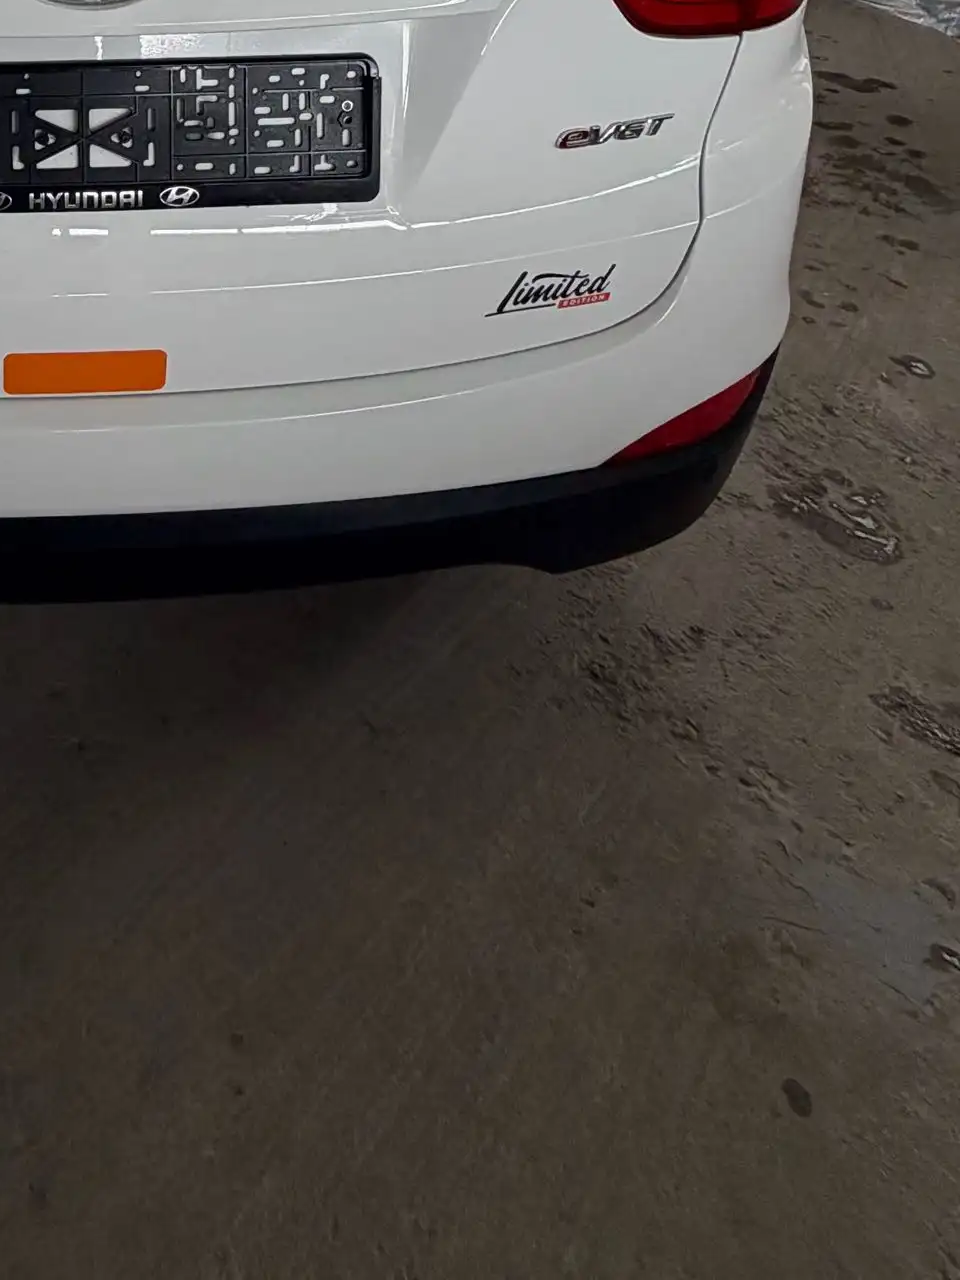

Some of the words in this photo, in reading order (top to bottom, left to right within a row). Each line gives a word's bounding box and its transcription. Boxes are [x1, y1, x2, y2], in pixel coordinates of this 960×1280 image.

[28, 190, 144, 210] HYUNDAI
[495, 263, 617, 314] Limited
[560, 293, 607, 308] EDITION
